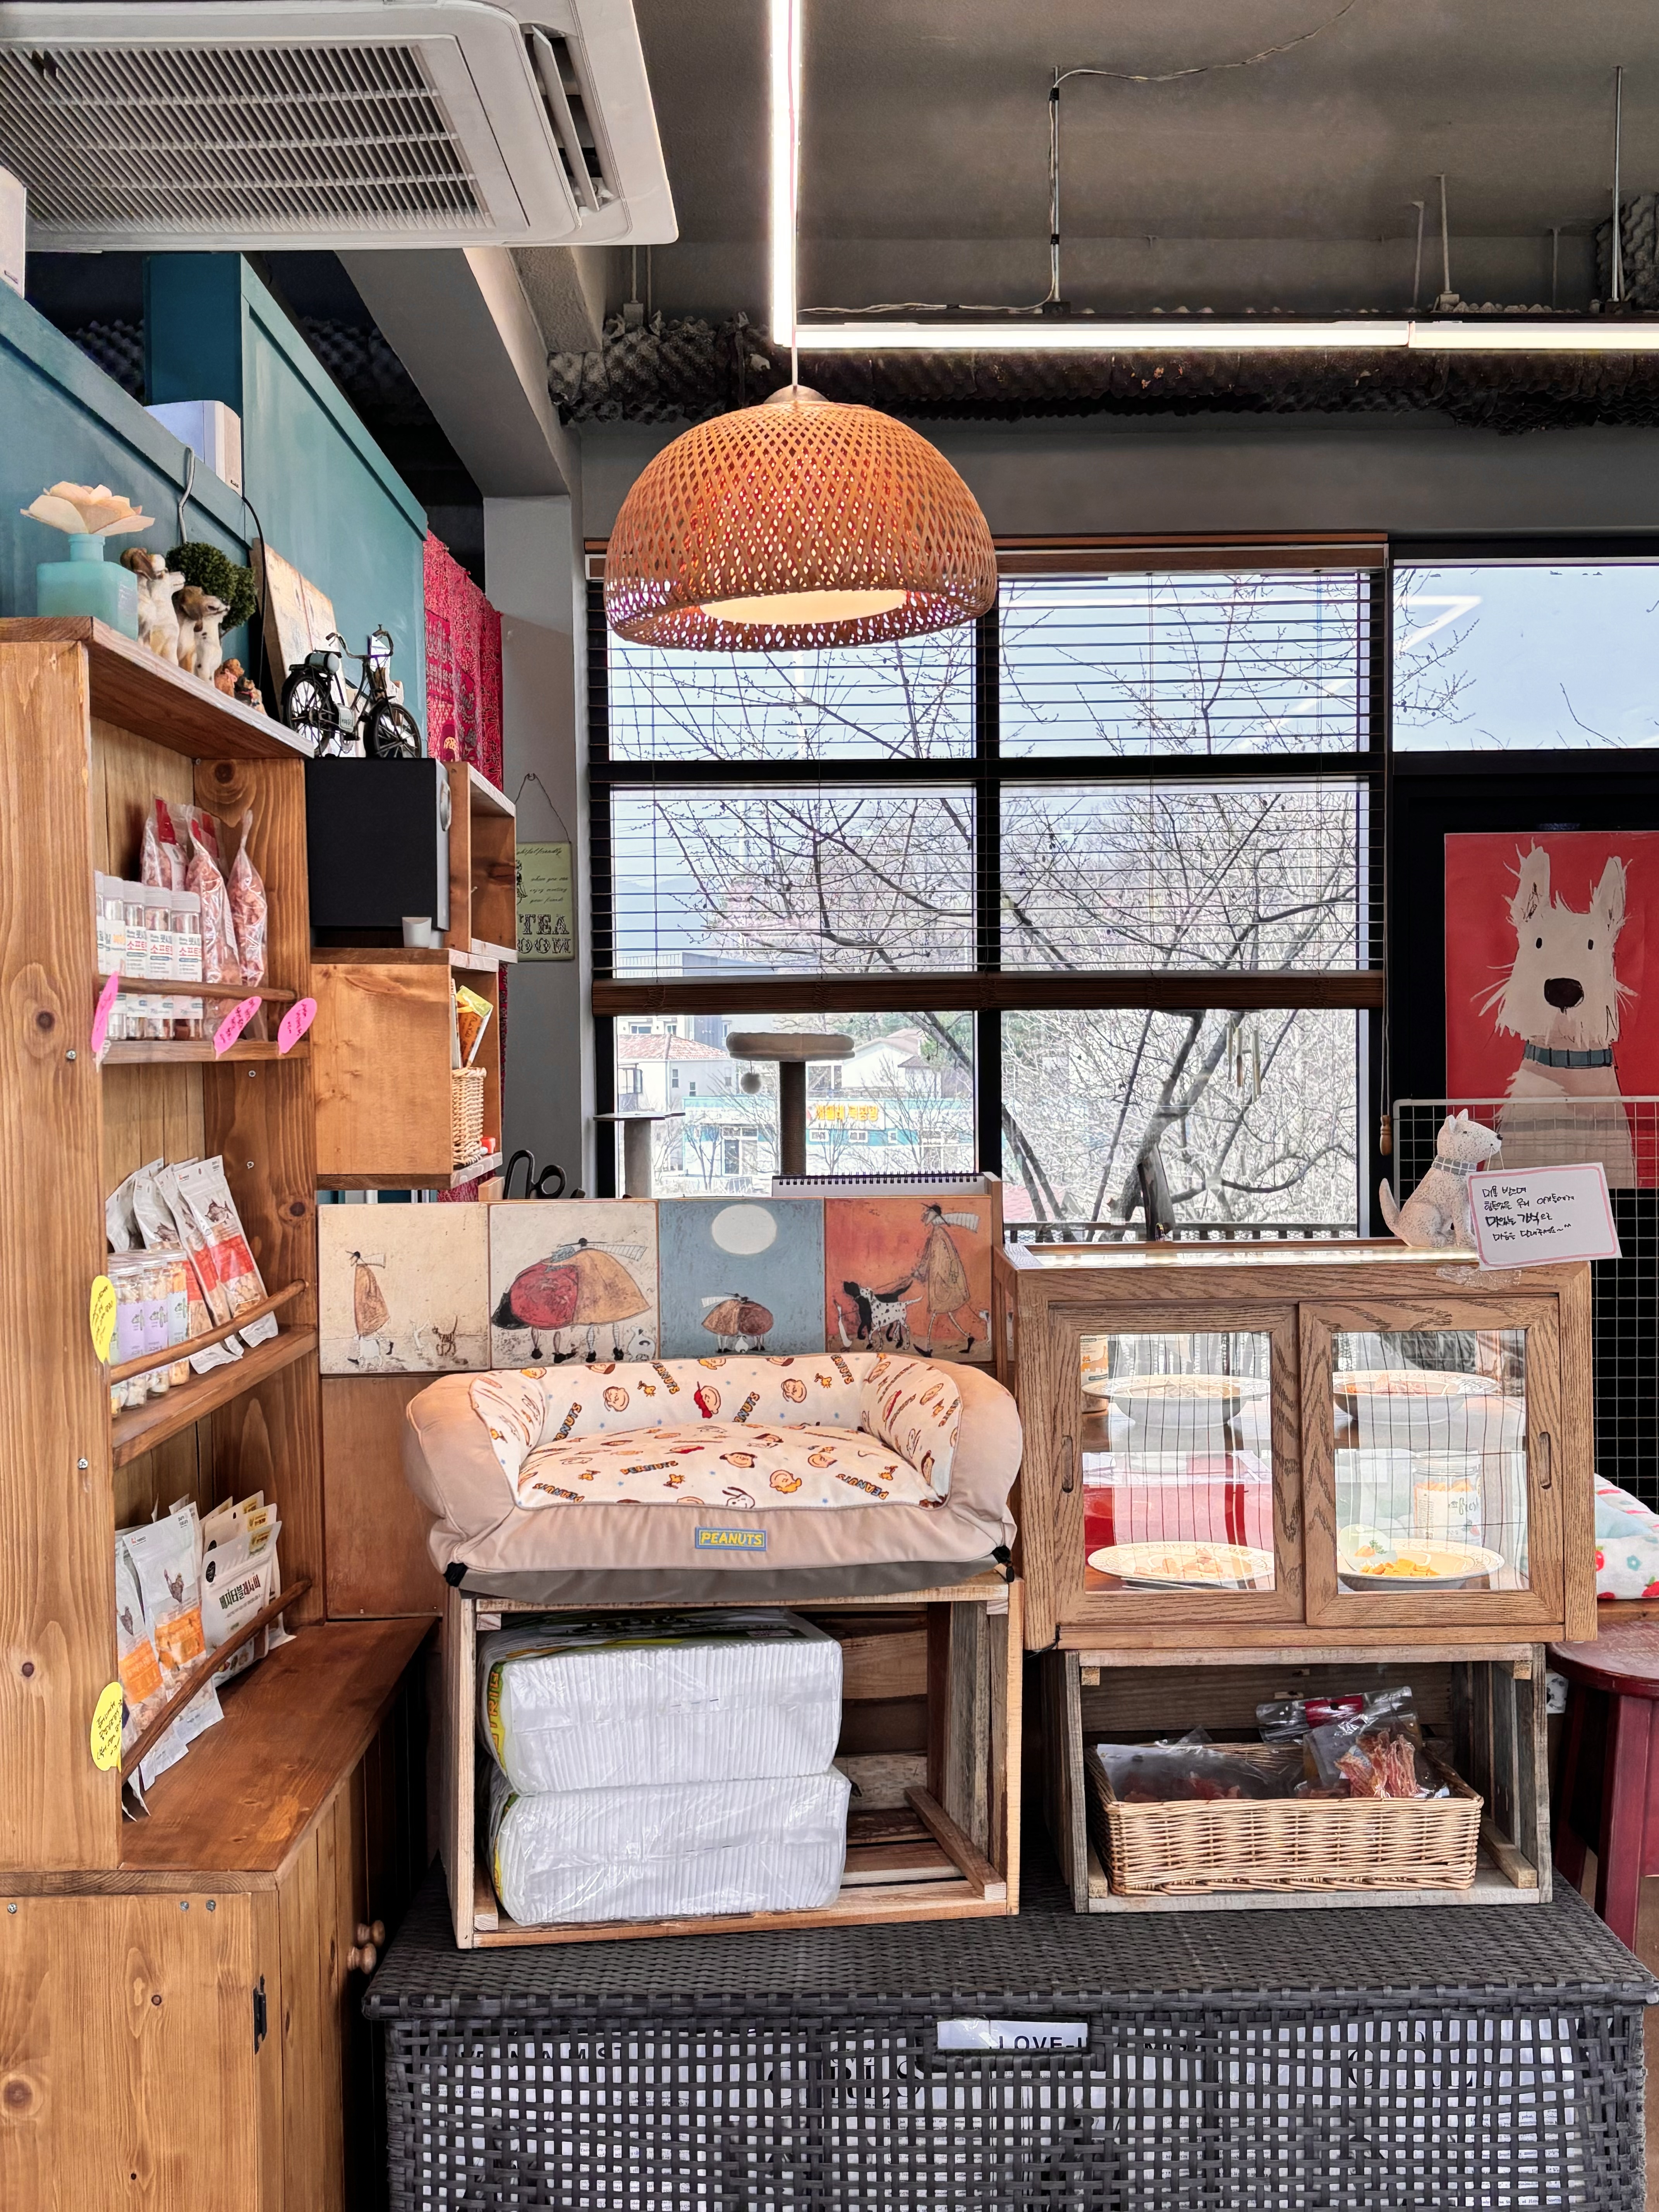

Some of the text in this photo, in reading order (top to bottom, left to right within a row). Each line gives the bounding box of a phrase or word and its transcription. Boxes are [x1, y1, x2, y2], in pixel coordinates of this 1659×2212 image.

[519, 914, 570, 935] TEA
[517, 937, 571, 954] OOM
[1516, 1198, 1530, 1208] 우리
[1485, 1212, 1553, 1228] 맛있는 간식으로
[835, 1474, 890, 1500] PEANUTS
[701, 1532, 763, 1546] PEANUTS
